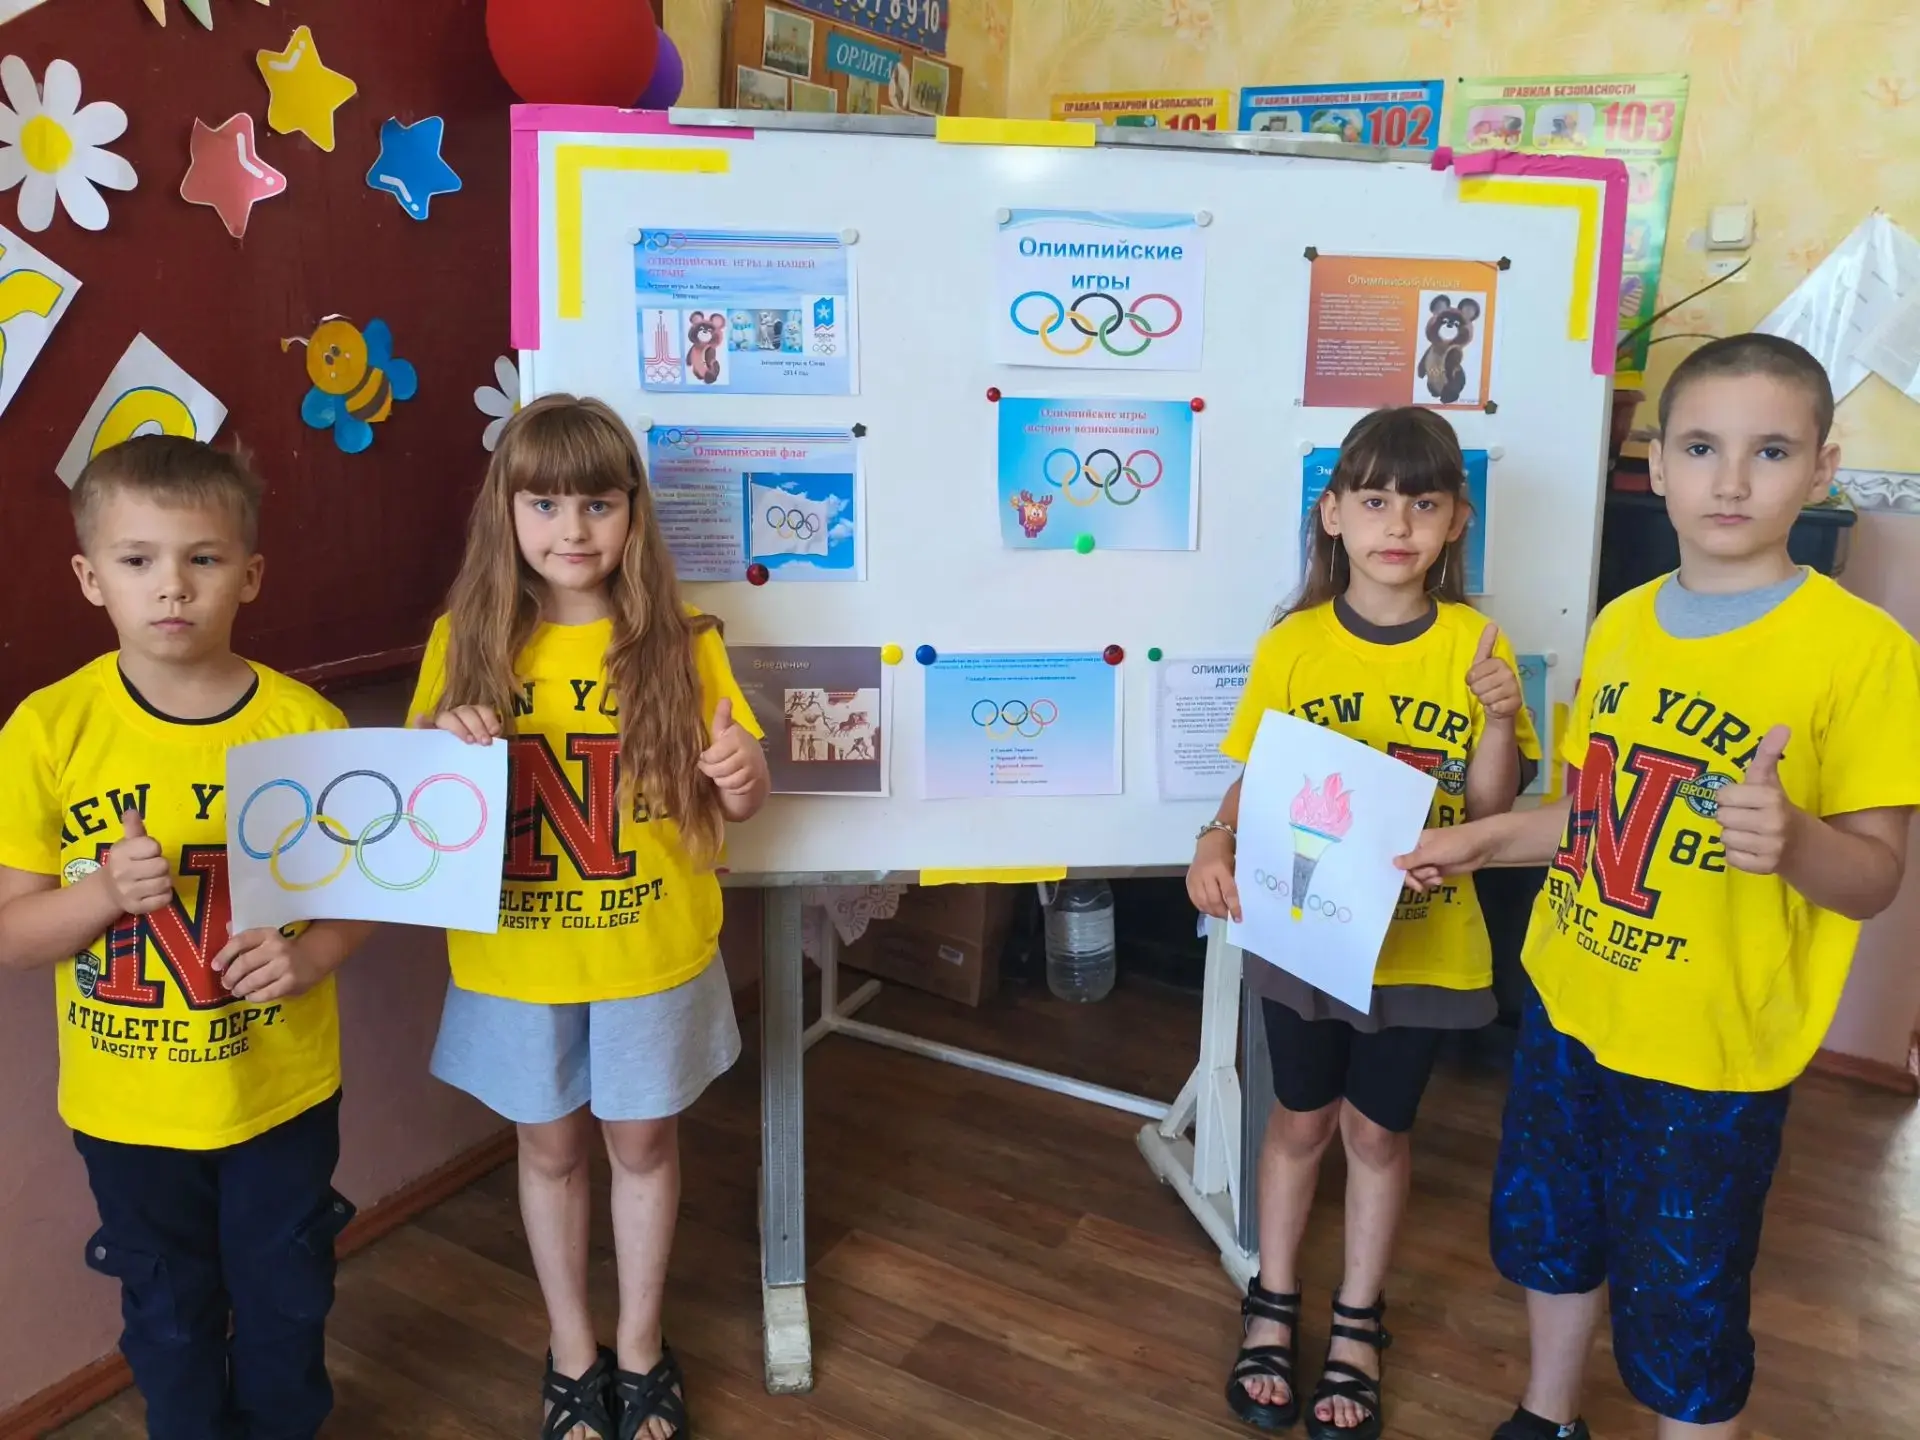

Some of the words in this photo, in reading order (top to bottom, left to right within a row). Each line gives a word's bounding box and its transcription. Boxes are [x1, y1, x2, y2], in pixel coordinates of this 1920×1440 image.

[922, 1, 940, 33] 10
[836, 42, 893, 79] ОРЛЯТА
[1064, 101, 1101, 112] ПРАВИЛА
[1102, 99, 1148, 111] ПОЖАРНОЙ
[1502, 86, 1551, 98] ПРАВИЛА
[1554, 84, 1636, 97] БЕЗОПАСНОСТИ
[1367, 105, 1433, 148] 102
[1602, 100, 1676, 142] 103
[1018, 236, 1184, 260] Олимпийские
[1071, 274, 1131, 294] игры
[1040, 408, 1117, 420] Олимпийские
[1119, 412, 1147, 422] игры
[692, 445, 777, 458] Олимпийский
[779, 446, 809, 461] флаг
[753, 658, 811, 672] Введение
[1288, 691, 1365, 727] EW
[1389, 694, 1472, 751] YOR
[1551, 730, 1710, 920] N
[1668, 828, 1727, 873] 82
[600, 878, 668, 912] DEPT.
[561, 910, 641, 929] COLLEGE
[1576, 931, 1643, 973] COLLEGE
[1607, 919, 1691, 963] DEPT.
[67, 1000, 191, 1044] ATHLETIC
[207, 1003, 287, 1044] DEPT.
[90, 1035, 158, 1061] VARSITY
[167, 1035, 251, 1063] COLLEGE
